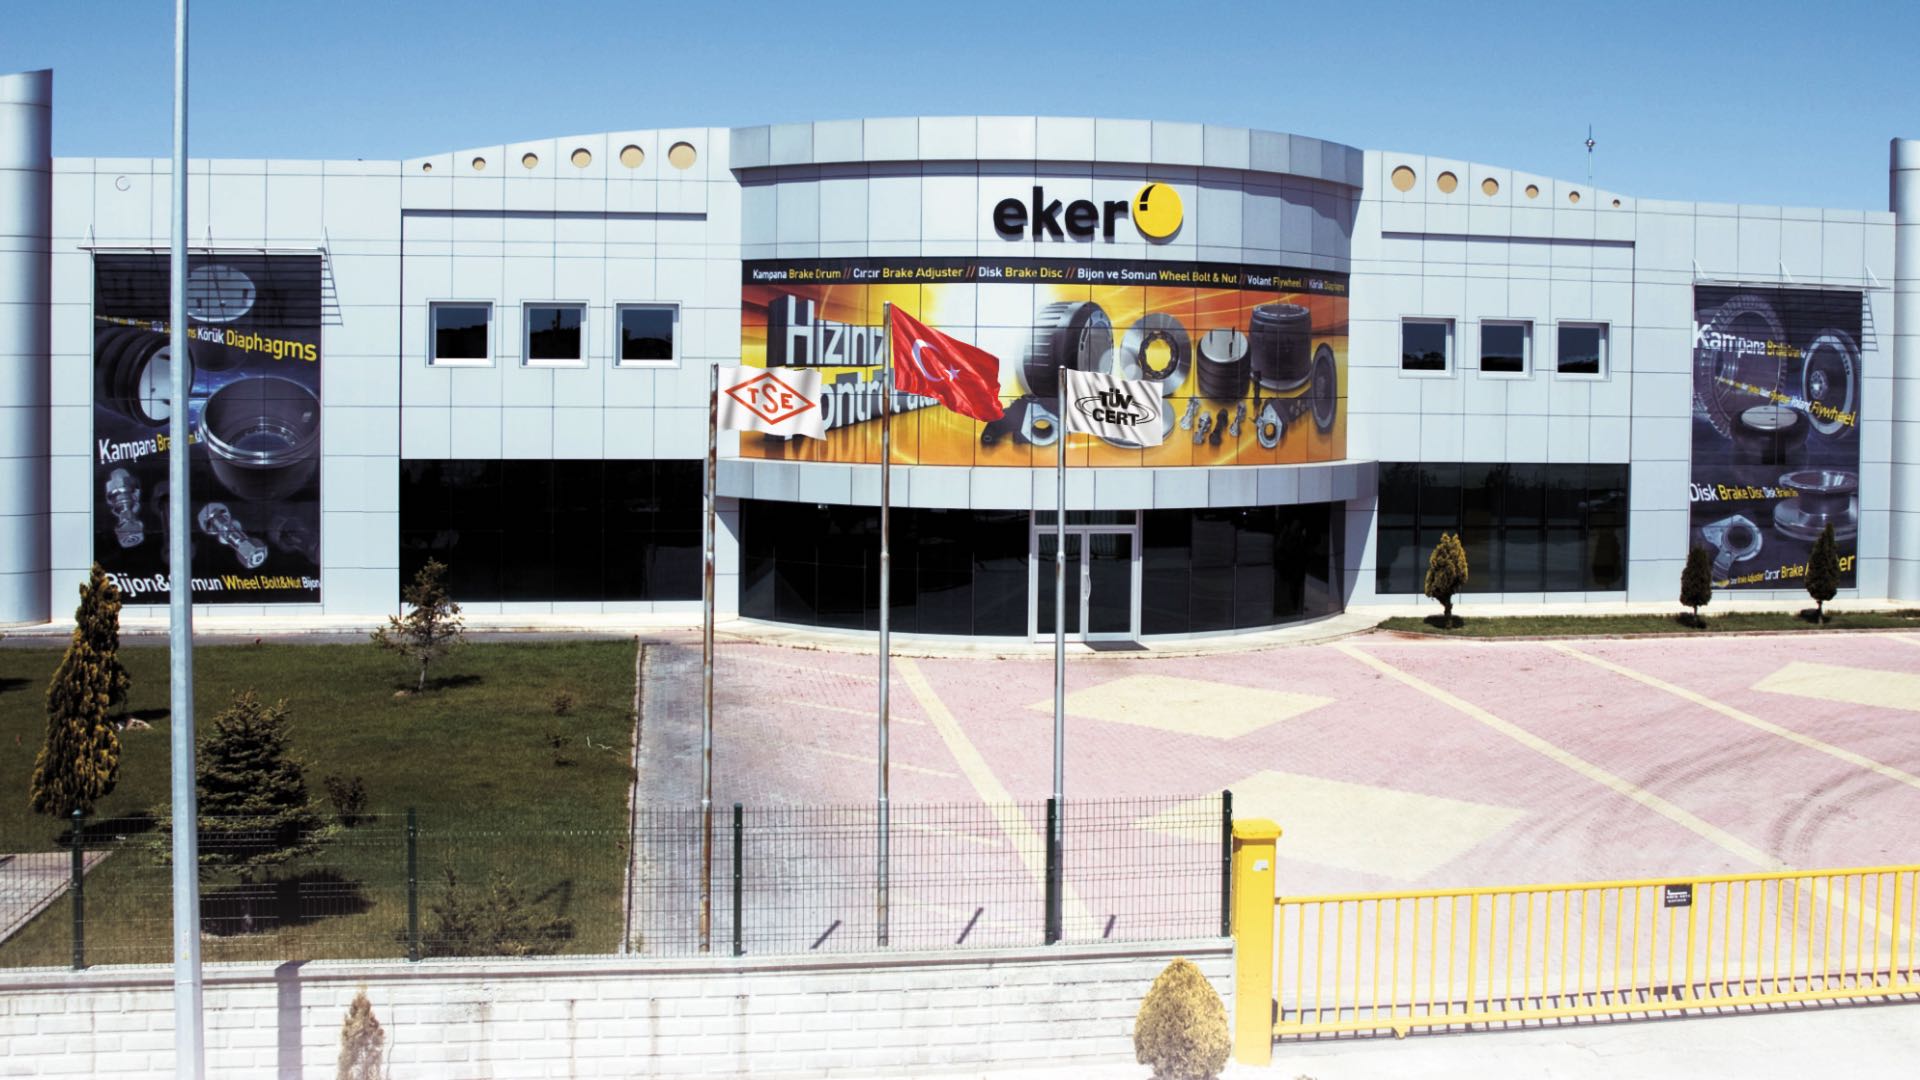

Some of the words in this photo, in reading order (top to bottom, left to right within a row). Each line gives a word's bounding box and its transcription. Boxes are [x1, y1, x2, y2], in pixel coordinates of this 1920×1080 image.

[993, 186, 1128, 237] eker
[753, 269, 787, 280] Kampana
[788, 268, 814, 279] Brake
[815, 268, 841, 279] Drum
[882, 267, 913, 278] Brake
[915, 267, 964, 279] Adjuster
[978, 266, 1003, 277] Disk
[1005, 266, 1038, 278] Brake
[1040, 267, 1063, 278] Disc
[1077, 268, 1104, 281] Bijon
[1106, 270, 1119, 279] ve
[1121, 269, 1157, 280] Somun
[1159, 270, 1190, 281] Wheel
[1192, 271, 1211, 282] Bolt
[1221, 273, 1237, 284] Nut
[1247, 274, 1272, 286] Volant
[226, 330, 317, 361] Diaphagms
[1692, 320, 1766, 358] Kampana
[747, 384, 793, 414] TSE
[1098, 387, 1133, 409] TÜV
[1092, 408, 1139, 426] CERT
[99, 438, 157, 464] Kampana
[1689, 483, 1719, 501] Disk
[1718, 484, 1748, 500] Brake
[1780, 563, 1803, 579] Brake
[221, 574, 261, 591] Wheel
